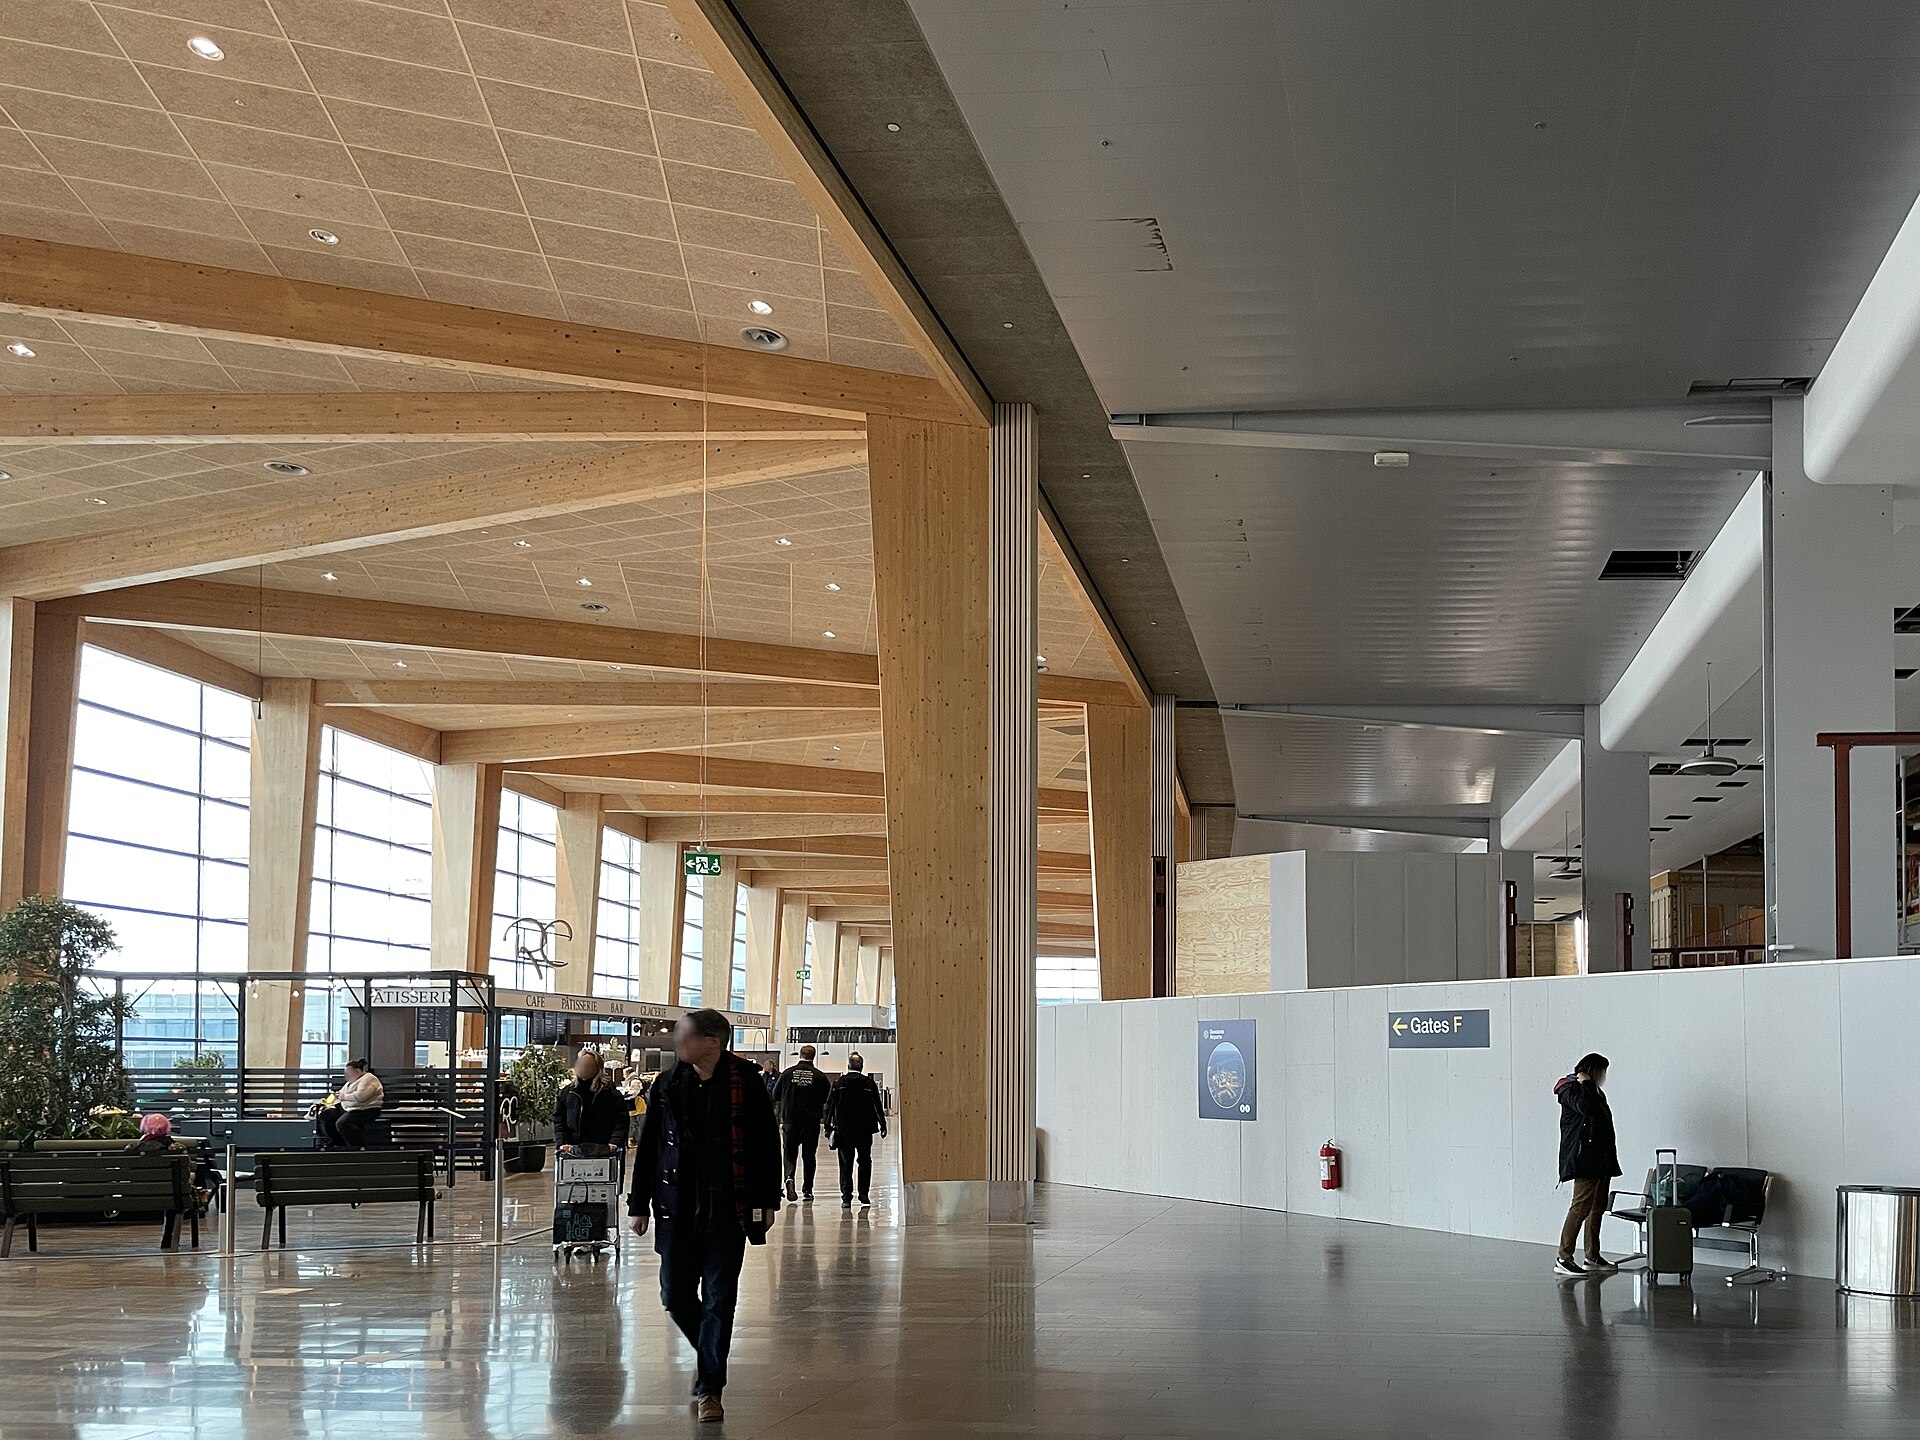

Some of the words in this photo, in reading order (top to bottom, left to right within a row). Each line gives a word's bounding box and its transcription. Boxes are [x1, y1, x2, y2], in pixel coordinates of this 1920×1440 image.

[371, 988, 450, 1004] ÂTISSERI
[610, 1003, 624, 1014] BAR
[640, 1006, 667, 1018] GLACERIE
[1410, 1017, 1450, 1034] Gates
[1453, 1016, 1463, 1033] F
